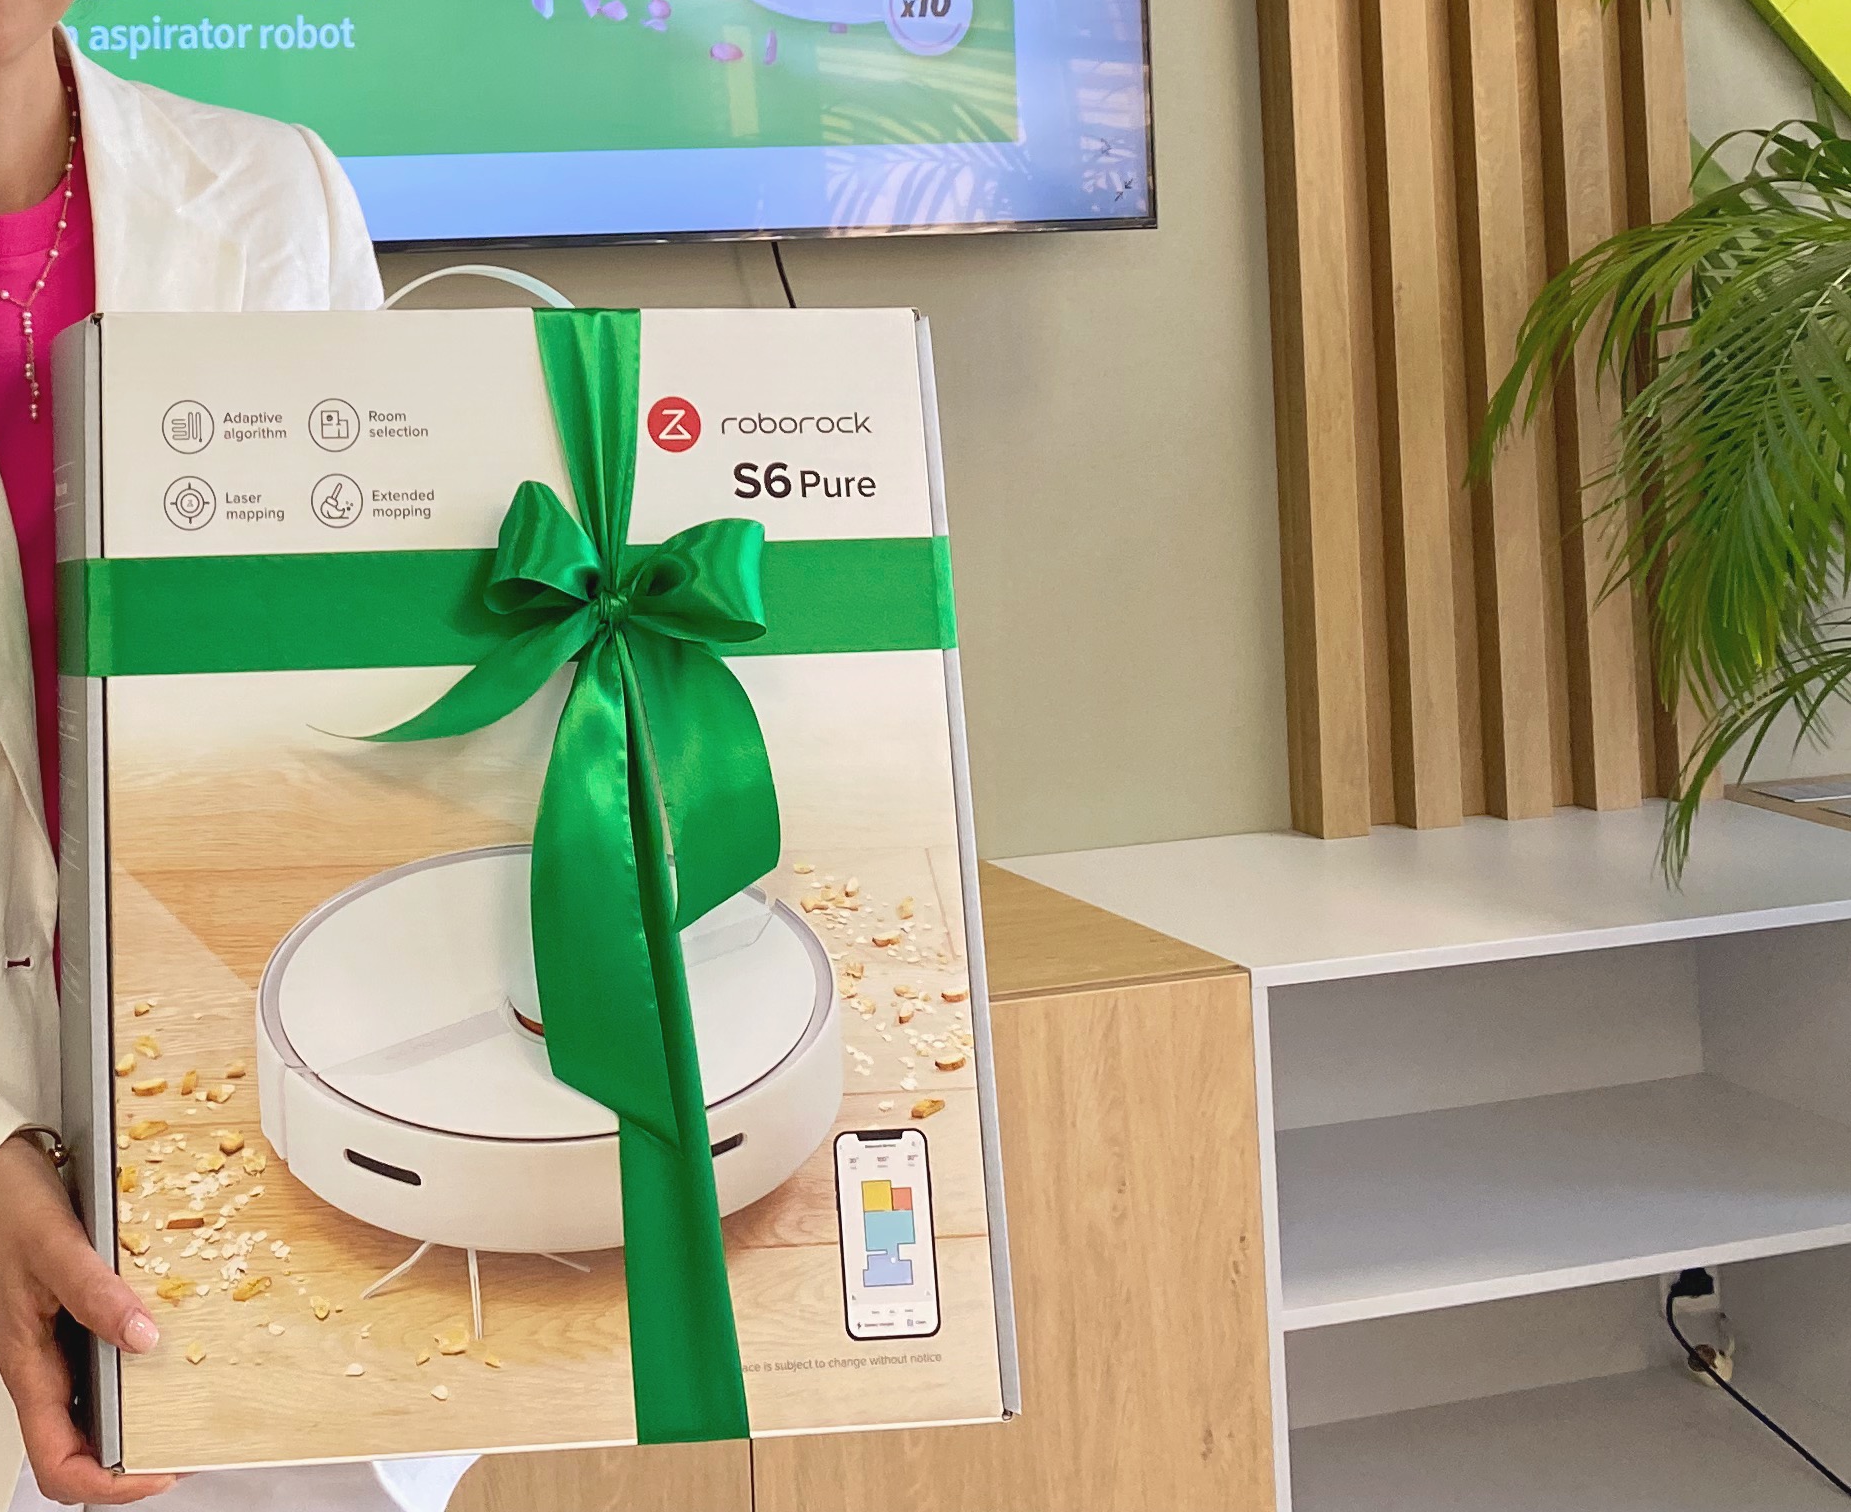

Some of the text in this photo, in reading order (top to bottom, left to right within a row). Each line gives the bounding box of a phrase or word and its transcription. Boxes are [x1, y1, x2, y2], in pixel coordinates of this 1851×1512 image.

[89, 15, 252, 60] aspirator
[260, 15, 355, 50] robot
[223, 412, 283, 427] Adaptive
[369, 410, 407, 423] Room
[721, 412, 872, 435] roborock
[223, 427, 288, 442] algorithm
[369, 425, 429, 438] selection
[733, 461, 877, 499] S6 Pure
[225, 492, 262, 504] Laser
[372, 489, 435, 502] Extended
[226, 508, 285, 522] mapping
[372, 504, 432, 519] mopping
[763, 1363, 773, 1372] is
[775, 1359, 813, 1372] subject
[814, 1359, 826, 1369] to
[828, 1356, 867, 1369] change
[869, 1354, 908, 1365] without
[910, 1353, 942, 1363] notice
